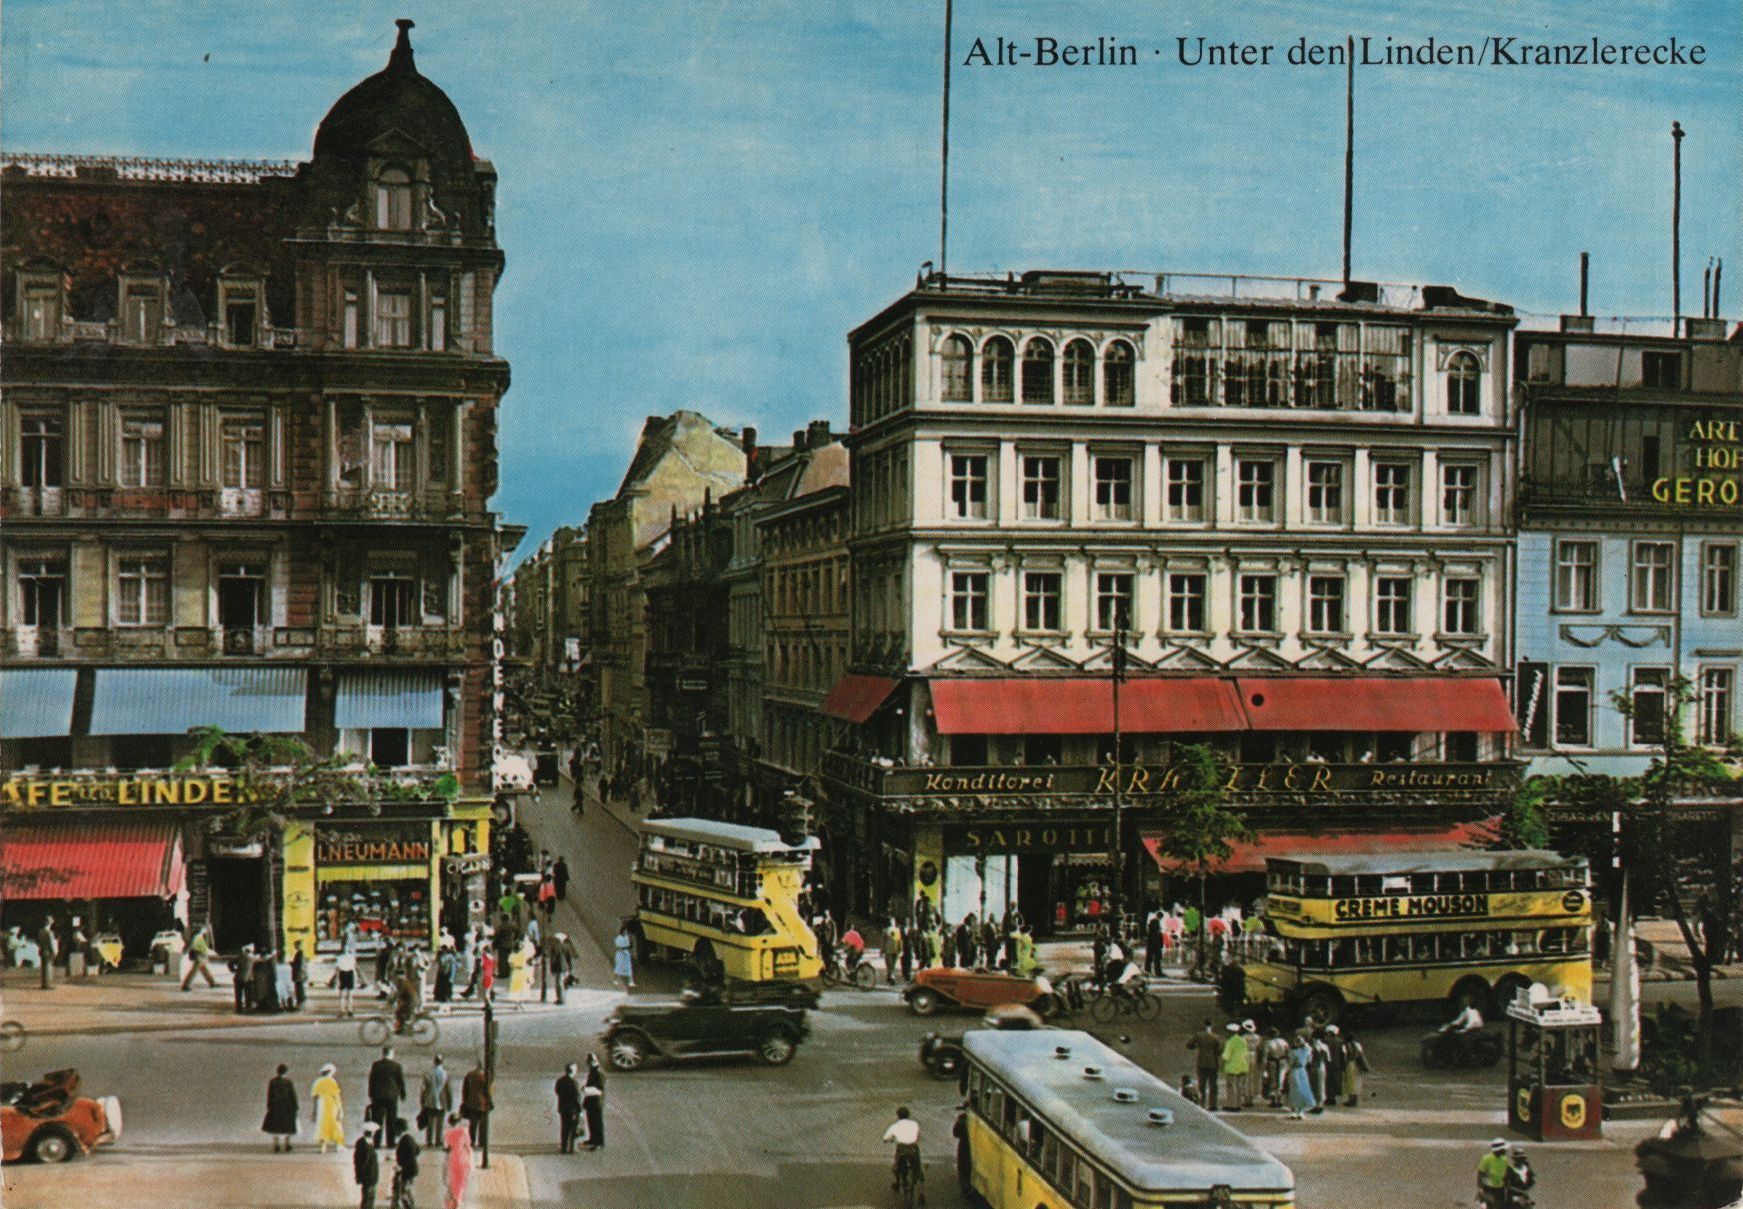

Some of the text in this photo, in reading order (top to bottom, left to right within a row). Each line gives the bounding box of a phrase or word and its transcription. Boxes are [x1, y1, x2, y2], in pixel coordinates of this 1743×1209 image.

[926, 774, 1054, 790] Konditorei
[1334, 897, 1400, 919] CREME
[1407, 893, 1489, 917] MOUSON
